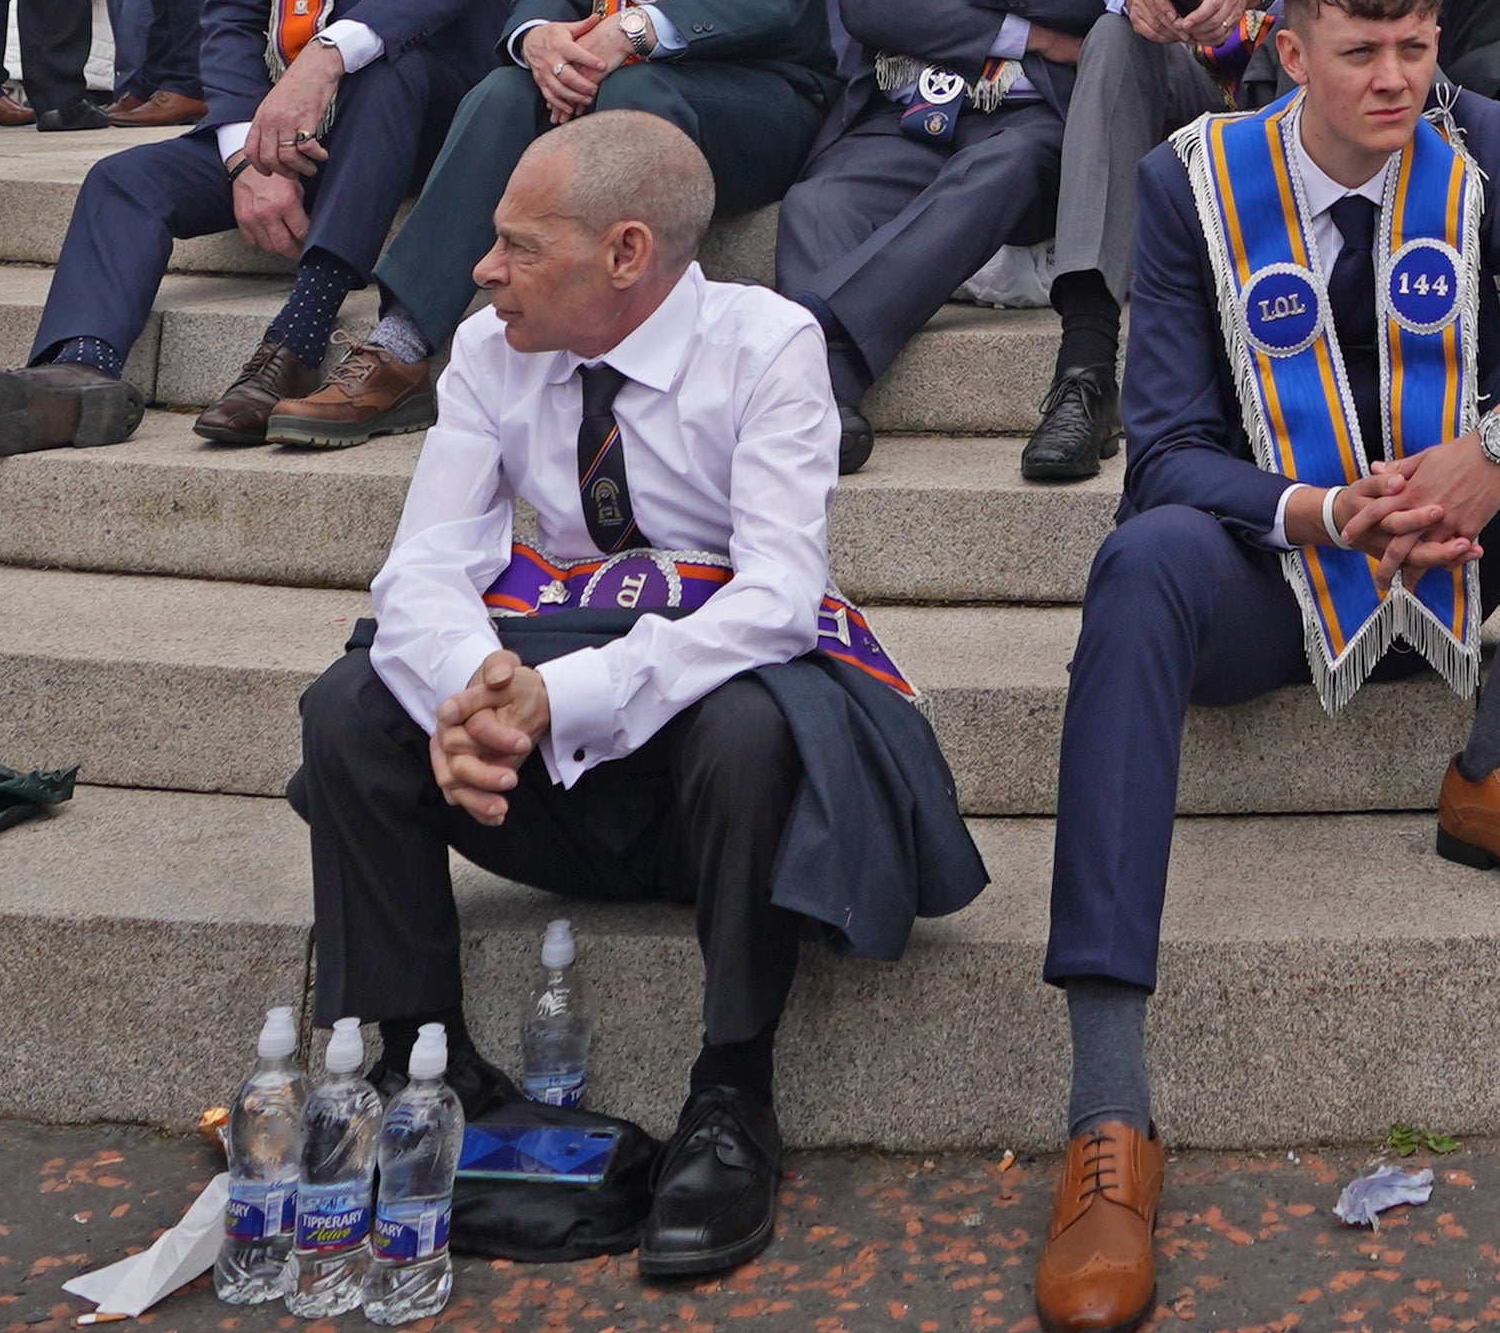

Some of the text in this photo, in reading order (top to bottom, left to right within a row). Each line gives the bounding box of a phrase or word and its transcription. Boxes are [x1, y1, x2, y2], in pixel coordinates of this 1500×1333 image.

[1398, 271, 1449, 297] 144
[1258, 292, 1306, 323] LOL
[616, 572, 647, 609] OL
[302, 1207, 365, 1230] TIPPERARY
[306, 1227, 353, 1242] Active
